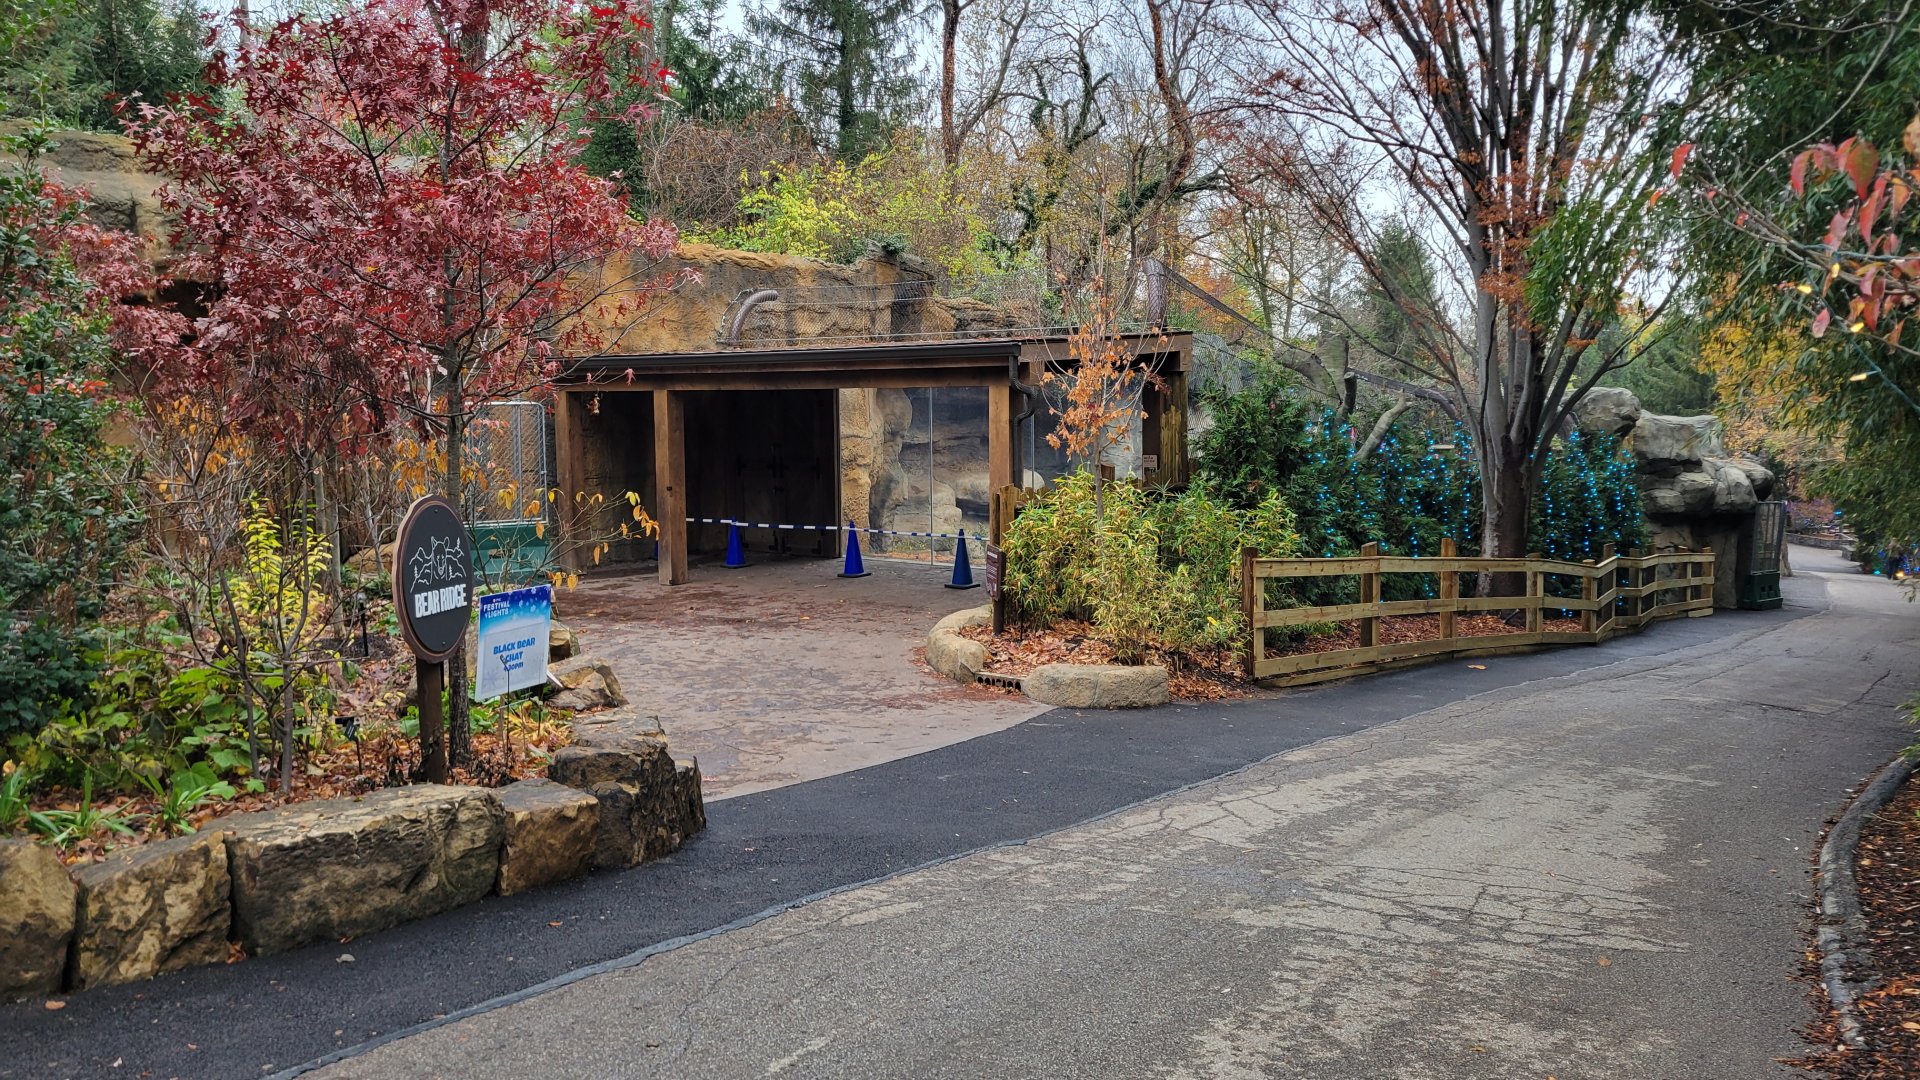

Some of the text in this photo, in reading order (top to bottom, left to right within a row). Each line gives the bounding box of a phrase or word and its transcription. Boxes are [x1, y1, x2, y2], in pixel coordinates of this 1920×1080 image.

[415, 584, 467, 618] BEAR RIDGE
[484, 600, 510, 612] FESTIVAL
[488, 607, 509, 618] LIGHTS
[493, 642, 515, 655] BLACK
[505, 651, 523, 664] CHAT
